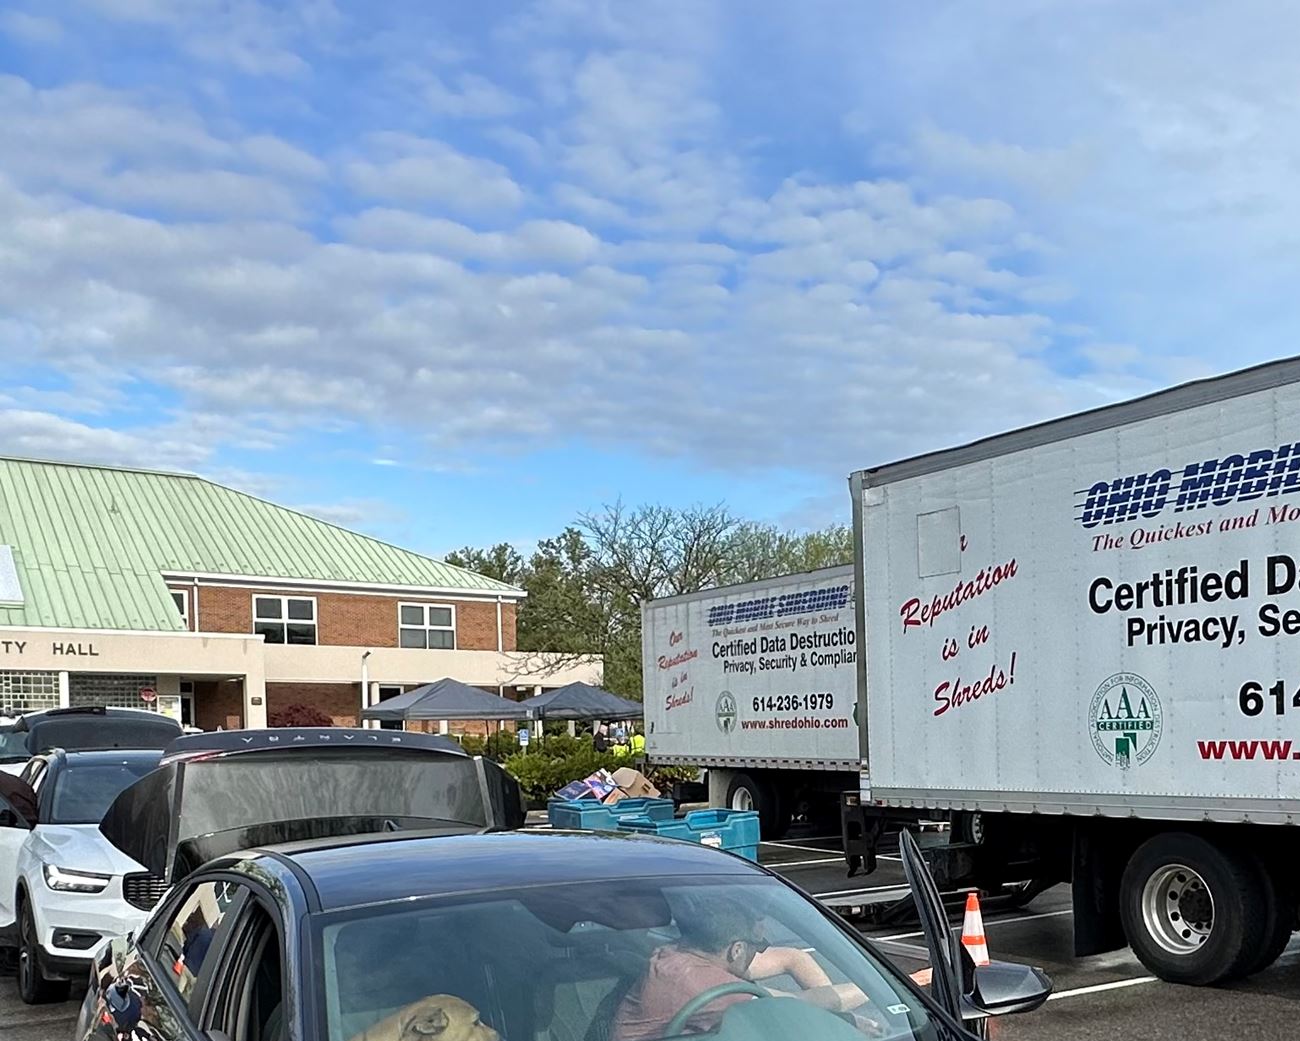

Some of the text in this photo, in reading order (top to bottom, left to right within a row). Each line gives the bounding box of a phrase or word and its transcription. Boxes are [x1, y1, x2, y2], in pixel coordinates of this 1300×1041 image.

[1082, 469, 1172, 528] OHIO
[1092, 534, 1124, 551] The
[1130, 518, 1213, 550] Quickest
[1219, 508, 1259, 532] and
[900, 558, 1019, 634] Reputation
[1088, 559, 1249, 614] Certified
[712, 627, 856, 659] Certified Data Destructio
[942, 625, 990, 660] is in
[1127, 614, 1245, 648] Privacy,
[52, 642, 99, 656] HALL
[723, 660, 757, 676] Privacy,
[759, 654, 798, 673] Security
[800, 652, 808, 668] &
[934, 652, 1017, 716] Shreds!
[752, 693, 834, 712] 614-236-1979
[1098, 685, 1152, 720] AAA
[741, 716, 849, 730] www.shredohio.com
[1098, 721, 1152, 731] CERTIFIED
